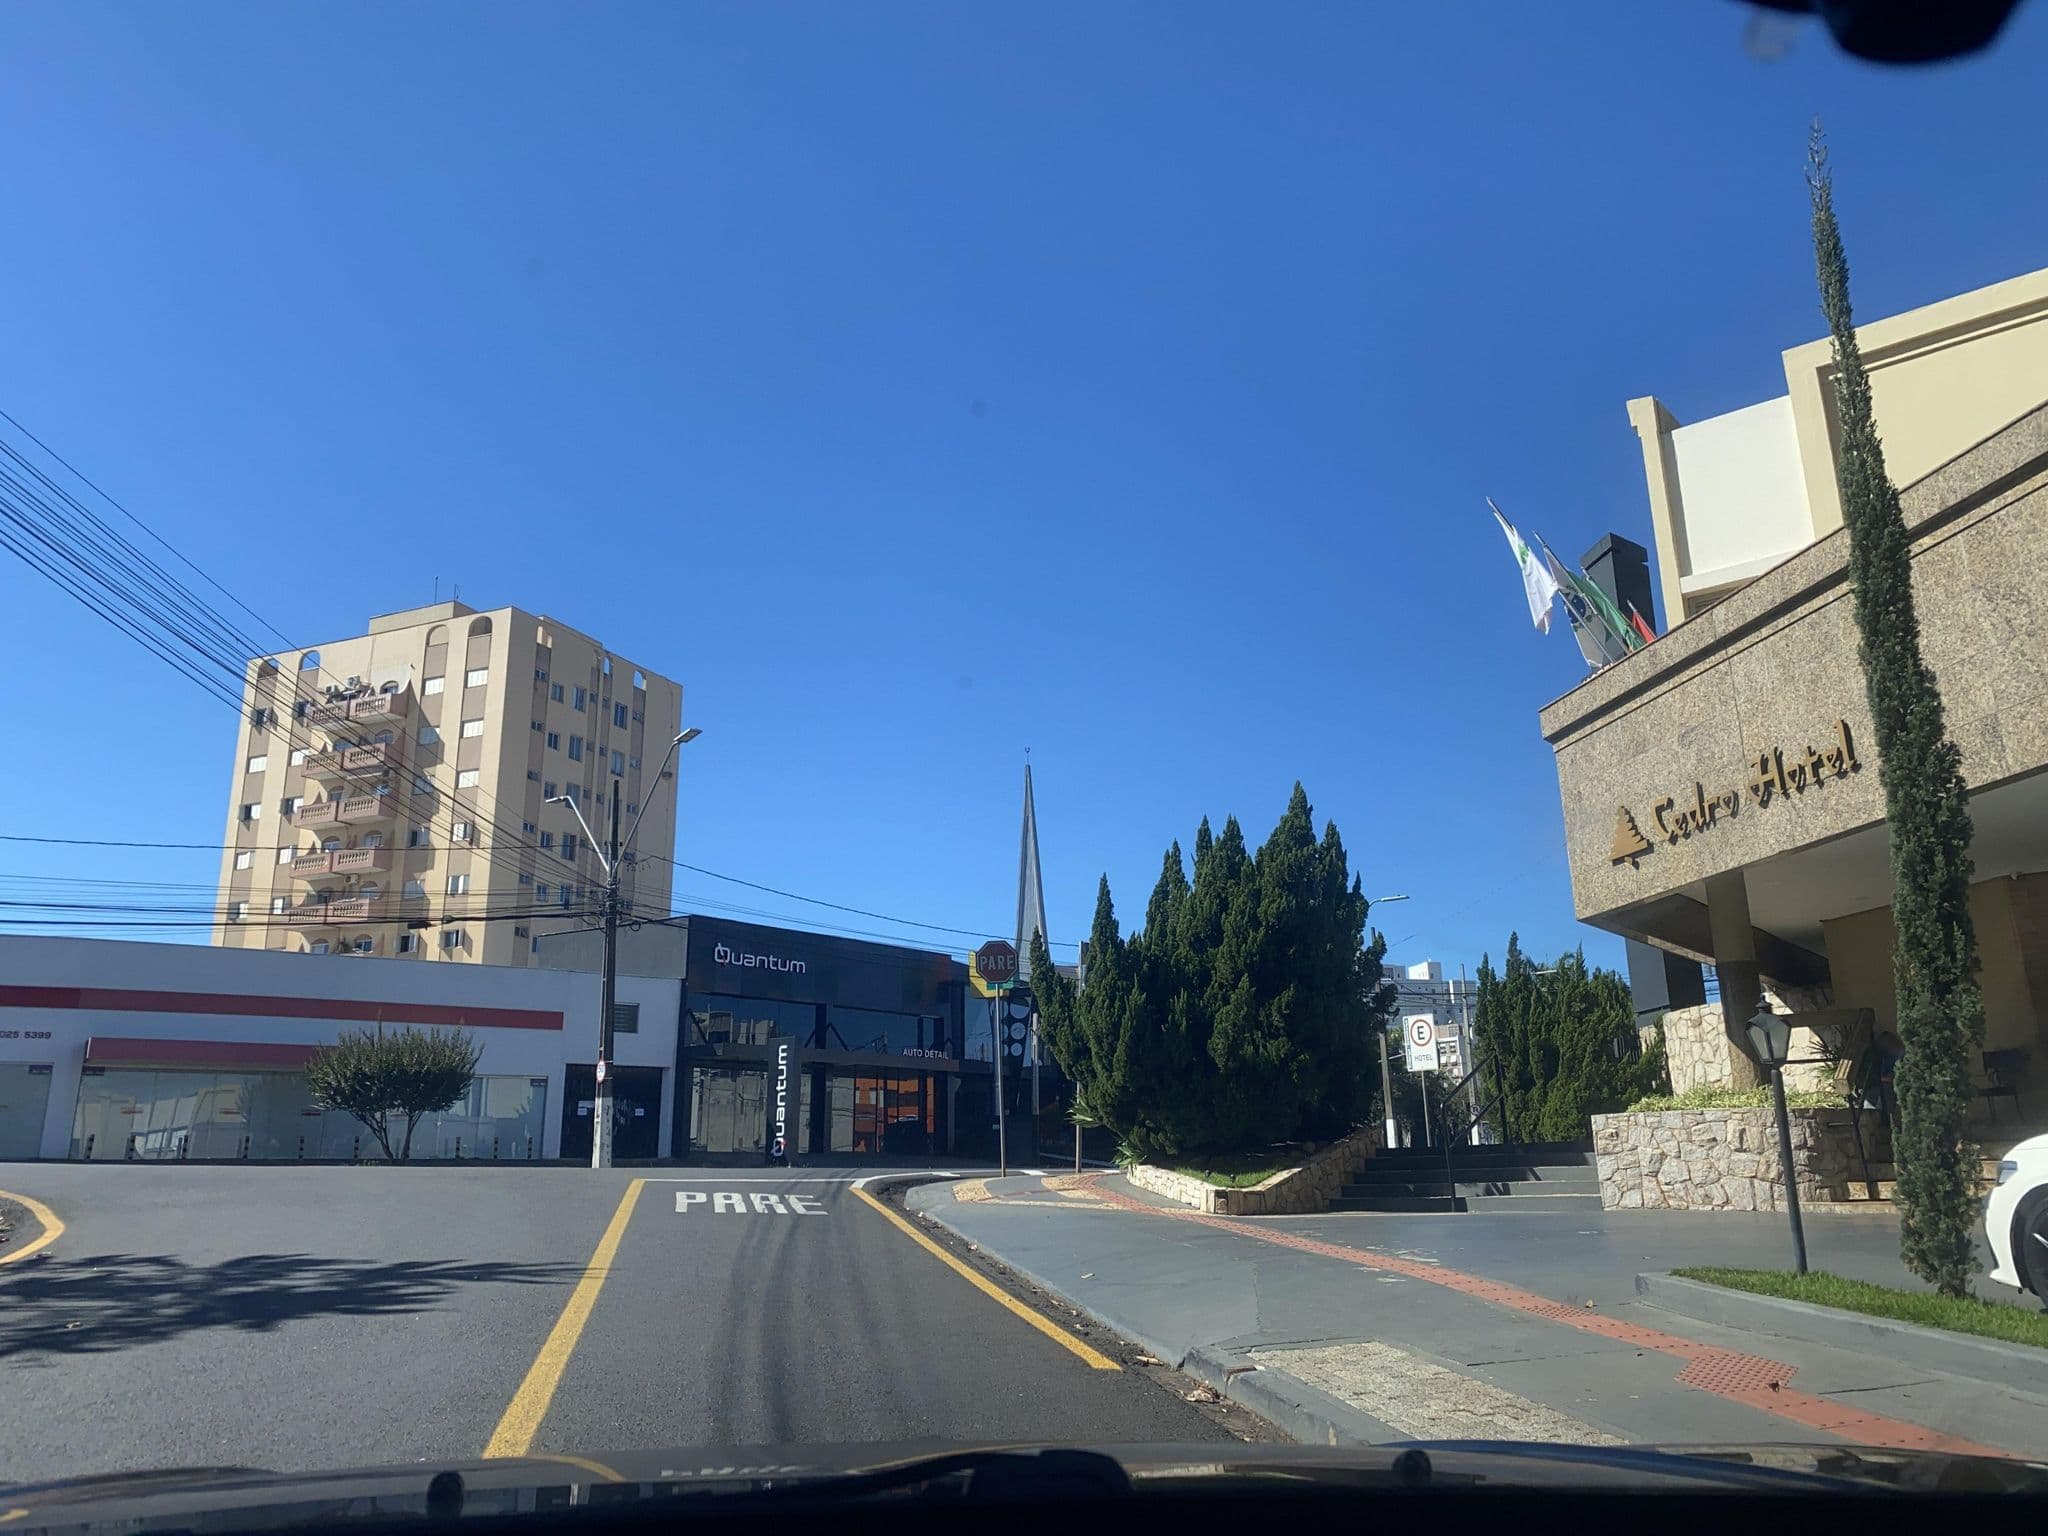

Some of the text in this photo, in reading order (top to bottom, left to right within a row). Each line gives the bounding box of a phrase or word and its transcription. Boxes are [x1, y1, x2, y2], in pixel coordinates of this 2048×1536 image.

[1650, 719, 1858, 843] Cedro Hotel
[714, 942, 806, 974] Quantum
[980, 954, 1015, 970] PARE
[1417, 1025, 1425, 1040] E
[902, 1048, 949, 1060] AUTO DETAIL
[771, 1044, 788, 1157] Quantum
[675, 1191, 829, 1215] PARE
